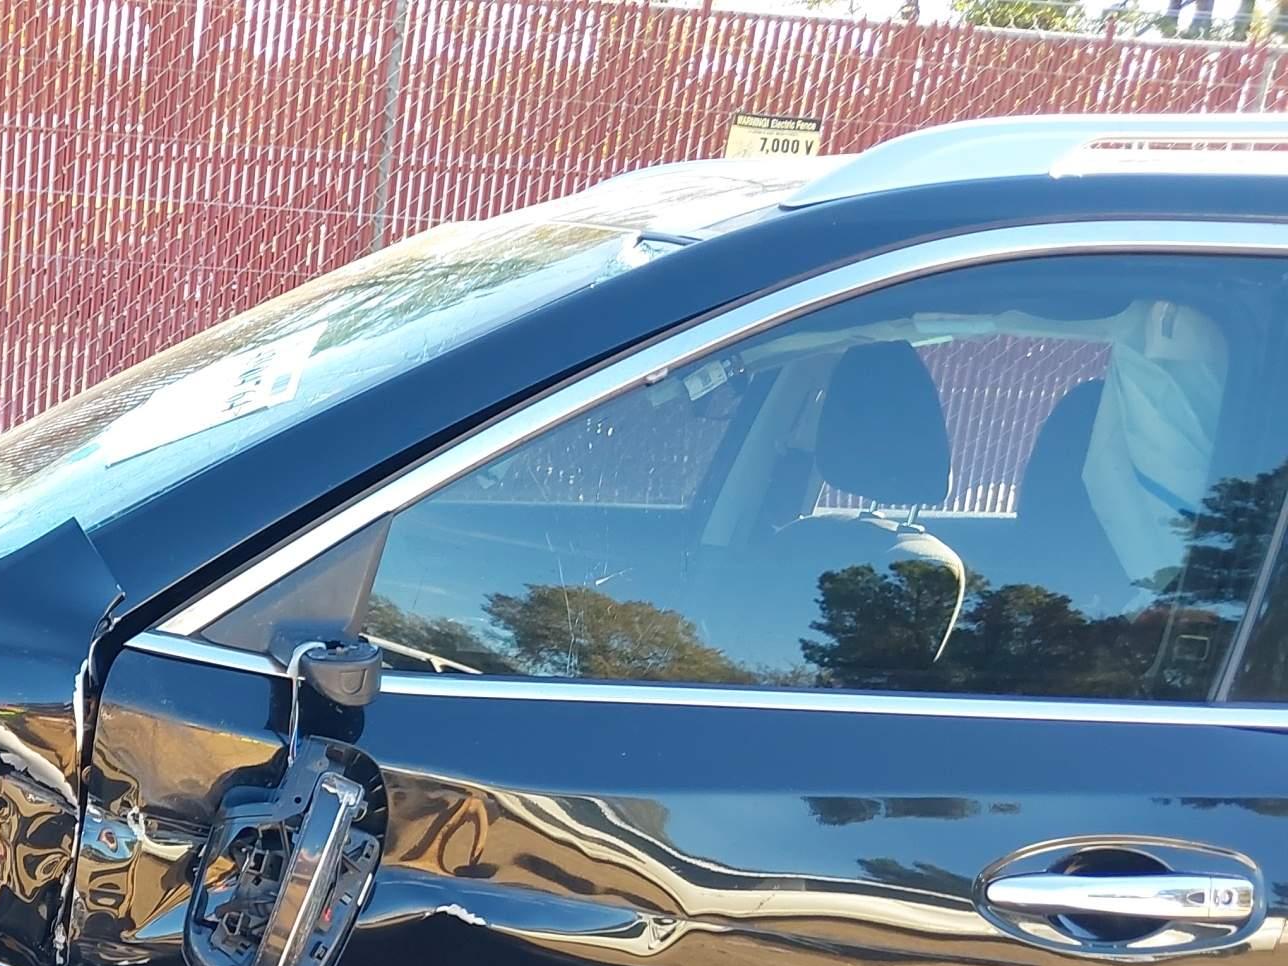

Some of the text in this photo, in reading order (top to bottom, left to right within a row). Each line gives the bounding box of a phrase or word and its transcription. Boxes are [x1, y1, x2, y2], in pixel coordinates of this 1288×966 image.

[770, 118, 795, 130] Electric
[795, 120, 817, 131] Fence
[759, 136, 815, 155] 7,000 V
